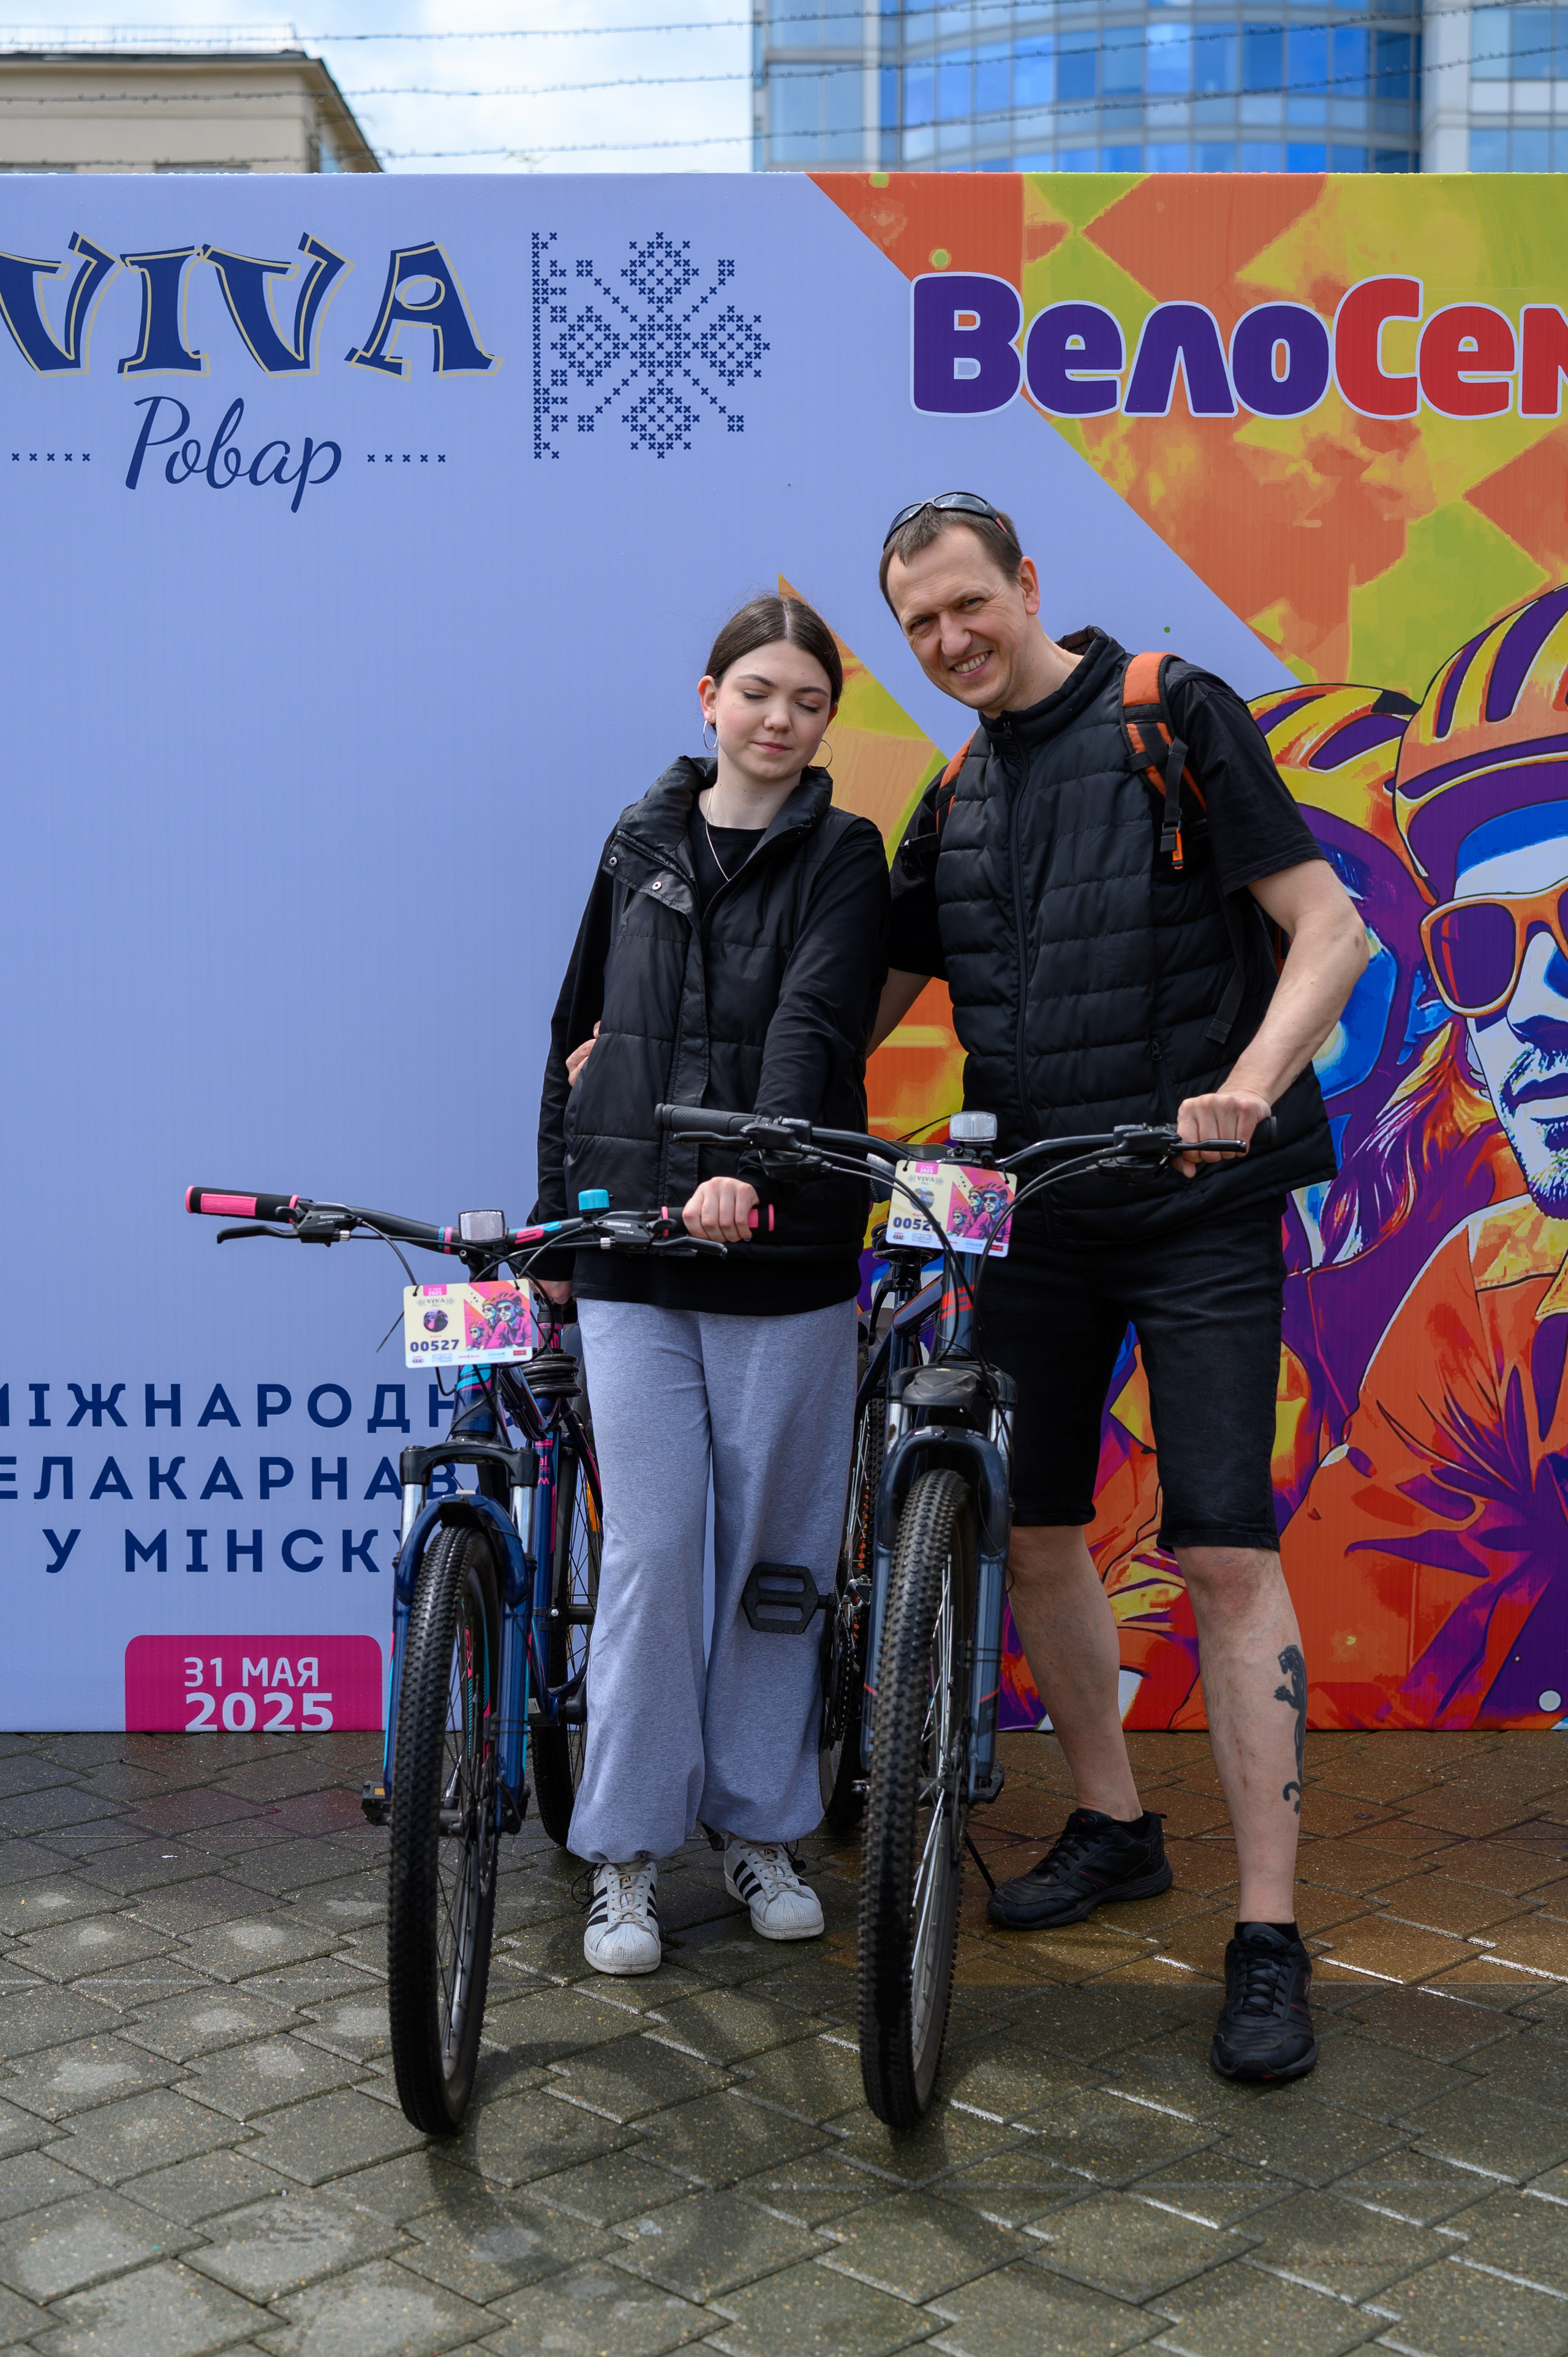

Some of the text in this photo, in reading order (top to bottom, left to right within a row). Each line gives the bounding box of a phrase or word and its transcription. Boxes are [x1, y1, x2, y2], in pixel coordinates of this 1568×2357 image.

[0, 231, 503, 381] VIVA
[125, 396, 342, 513] Ровар
[893, 1216, 941, 1231] 0052
[410, 1339, 459, 1352] 00527
[0, 1383, 514, 1433] ІЖНАРОДН
[0, 1456, 481, 1500] ЕЛАКАРНАВ
[42, 1529, 401, 1574] У МІНСК
[184, 1657, 318, 1687] 31 МАЯ
[185, 1692, 333, 1732] 2025
